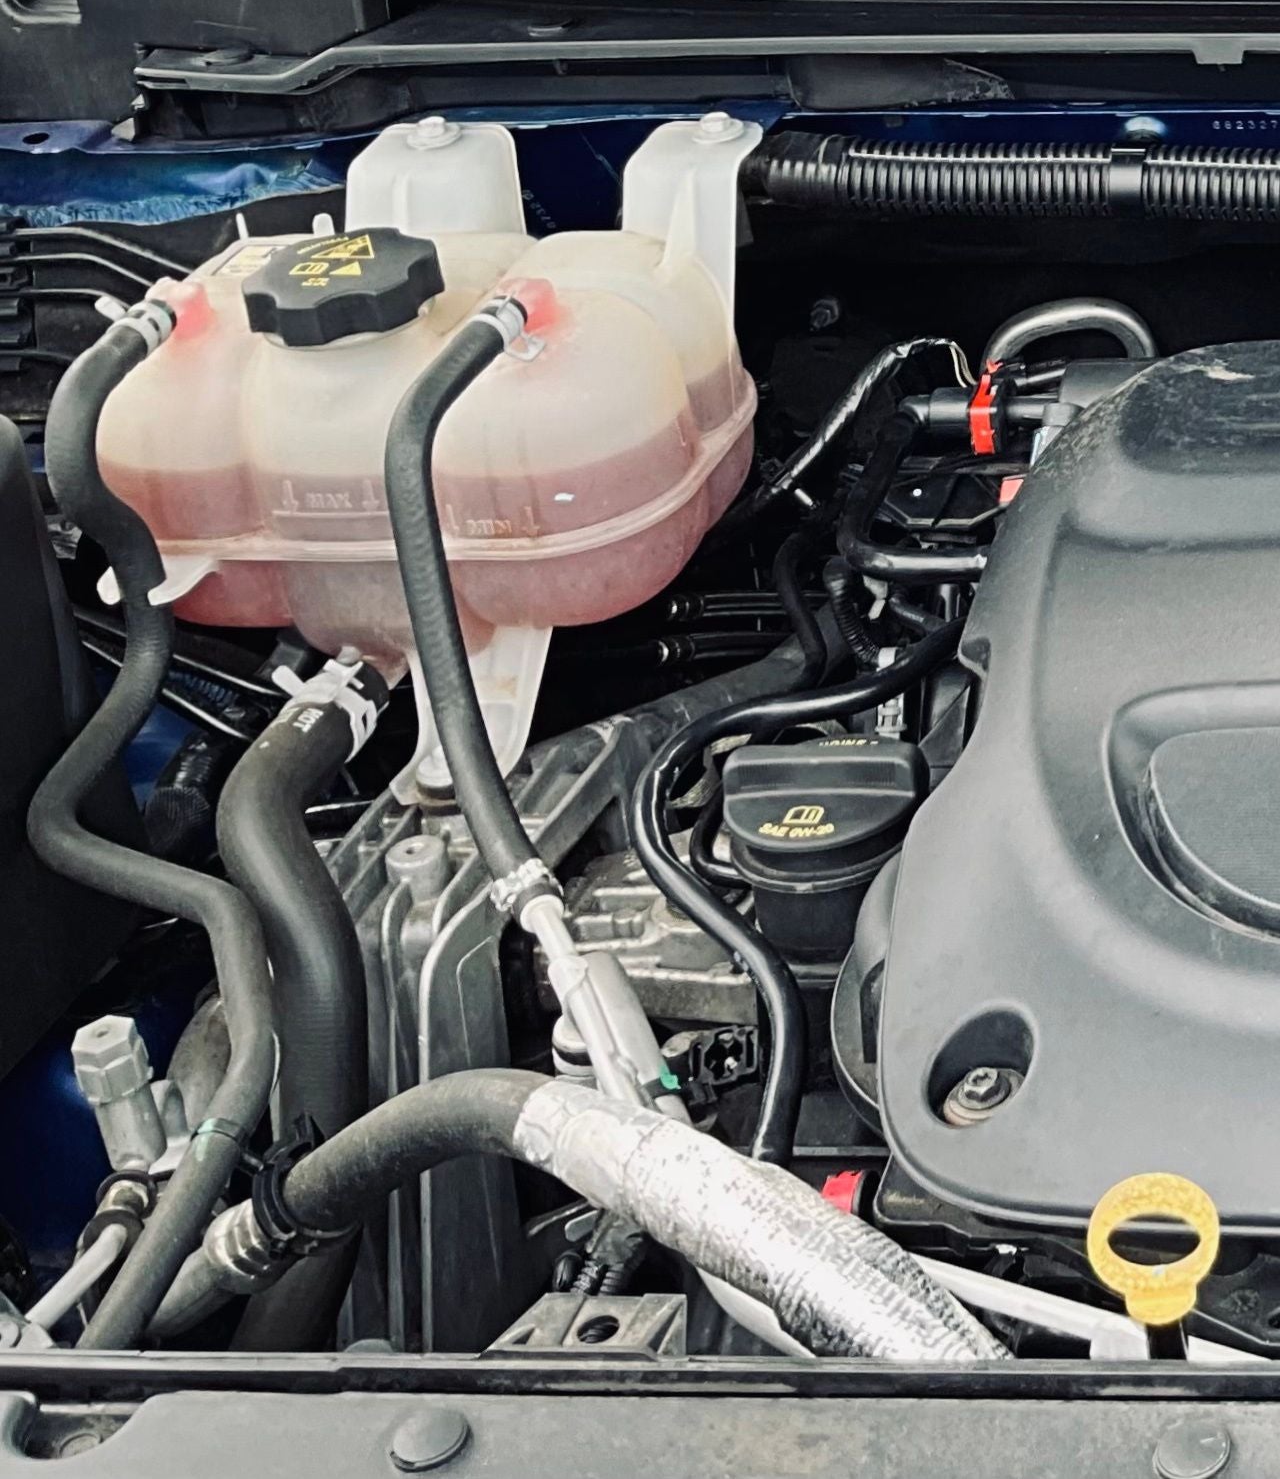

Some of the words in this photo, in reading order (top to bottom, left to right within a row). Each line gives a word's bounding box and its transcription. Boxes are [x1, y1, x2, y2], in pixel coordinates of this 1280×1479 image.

[306, 492, 352, 508] MAX
[759, 822, 790, 837] SAE
[789, 822, 835, 839] 0W-20
